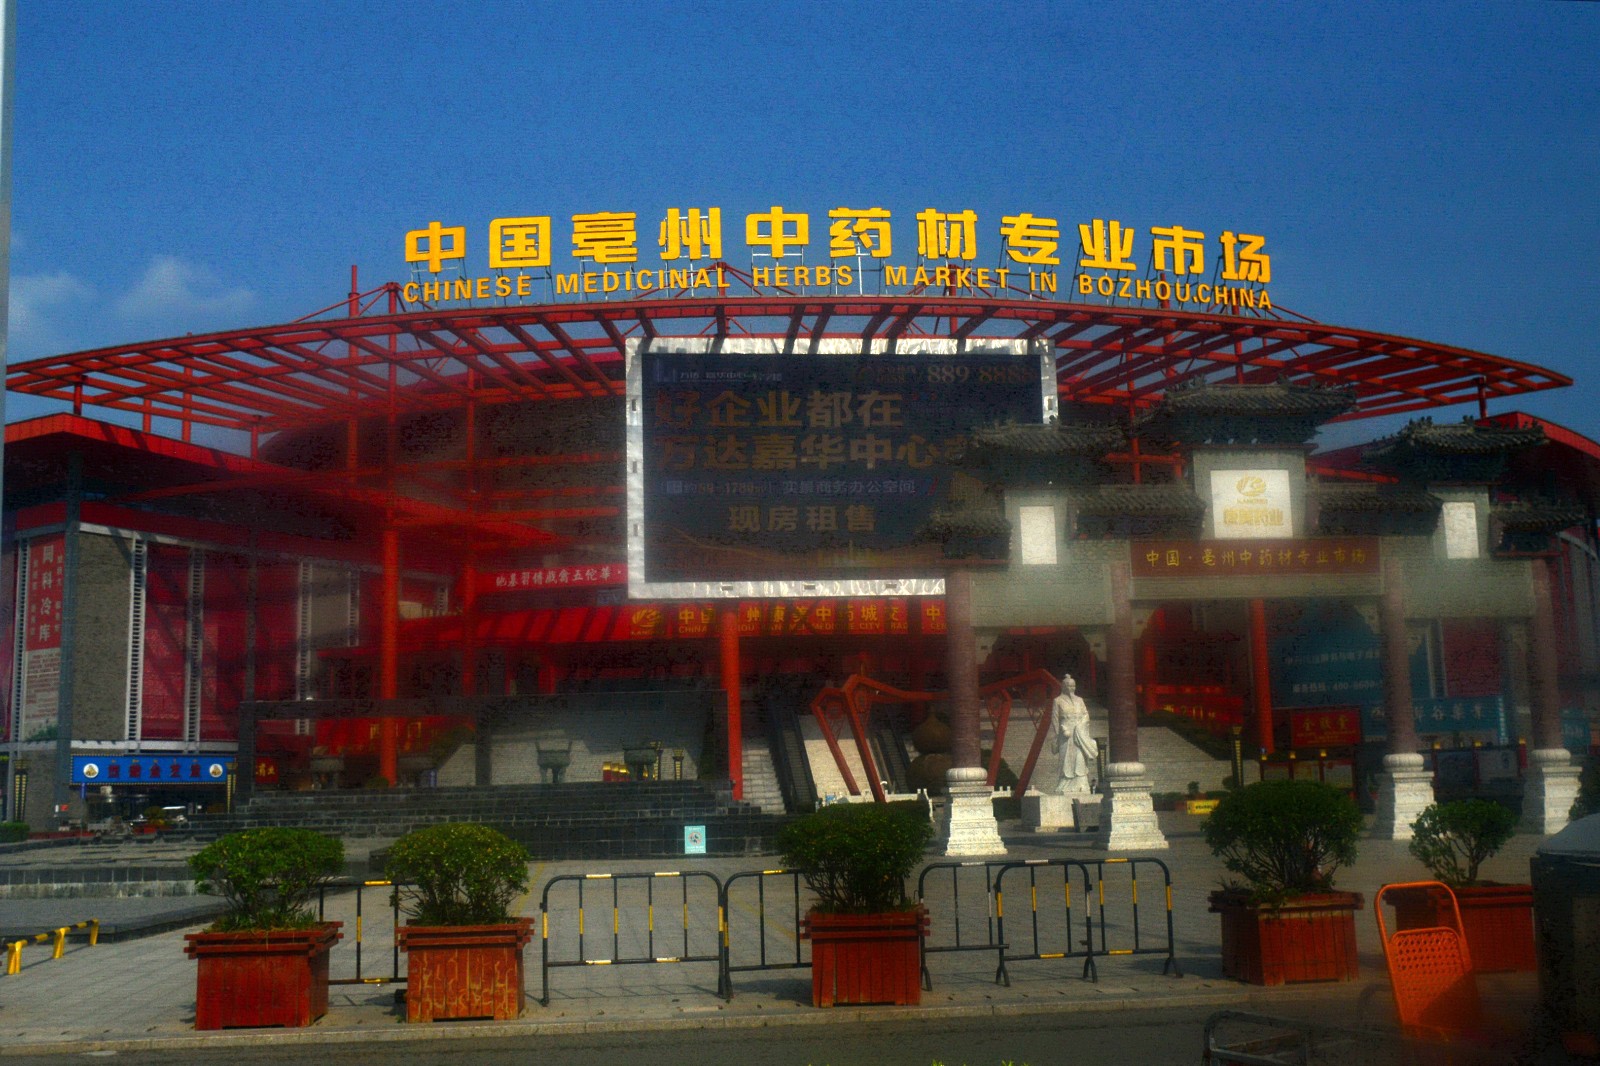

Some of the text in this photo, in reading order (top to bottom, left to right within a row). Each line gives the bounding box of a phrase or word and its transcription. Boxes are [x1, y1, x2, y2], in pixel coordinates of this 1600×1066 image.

[405, 206, 1271, 283] 中国亳州中药材专业市场
[403, 275, 532, 303] CHINESE
[556, 267, 731, 296] MEDICINAL
[753, 266, 853, 288] HERBS
[885, 265, 1010, 289] MARKET
[1030, 270, 1058, 293] IN
[927, 364, 970, 384] 889
[656, 389, 904, 428] 好企业都在
[728, 504, 877, 532] 现房租售
[859, 622, 880, 631] CITY
